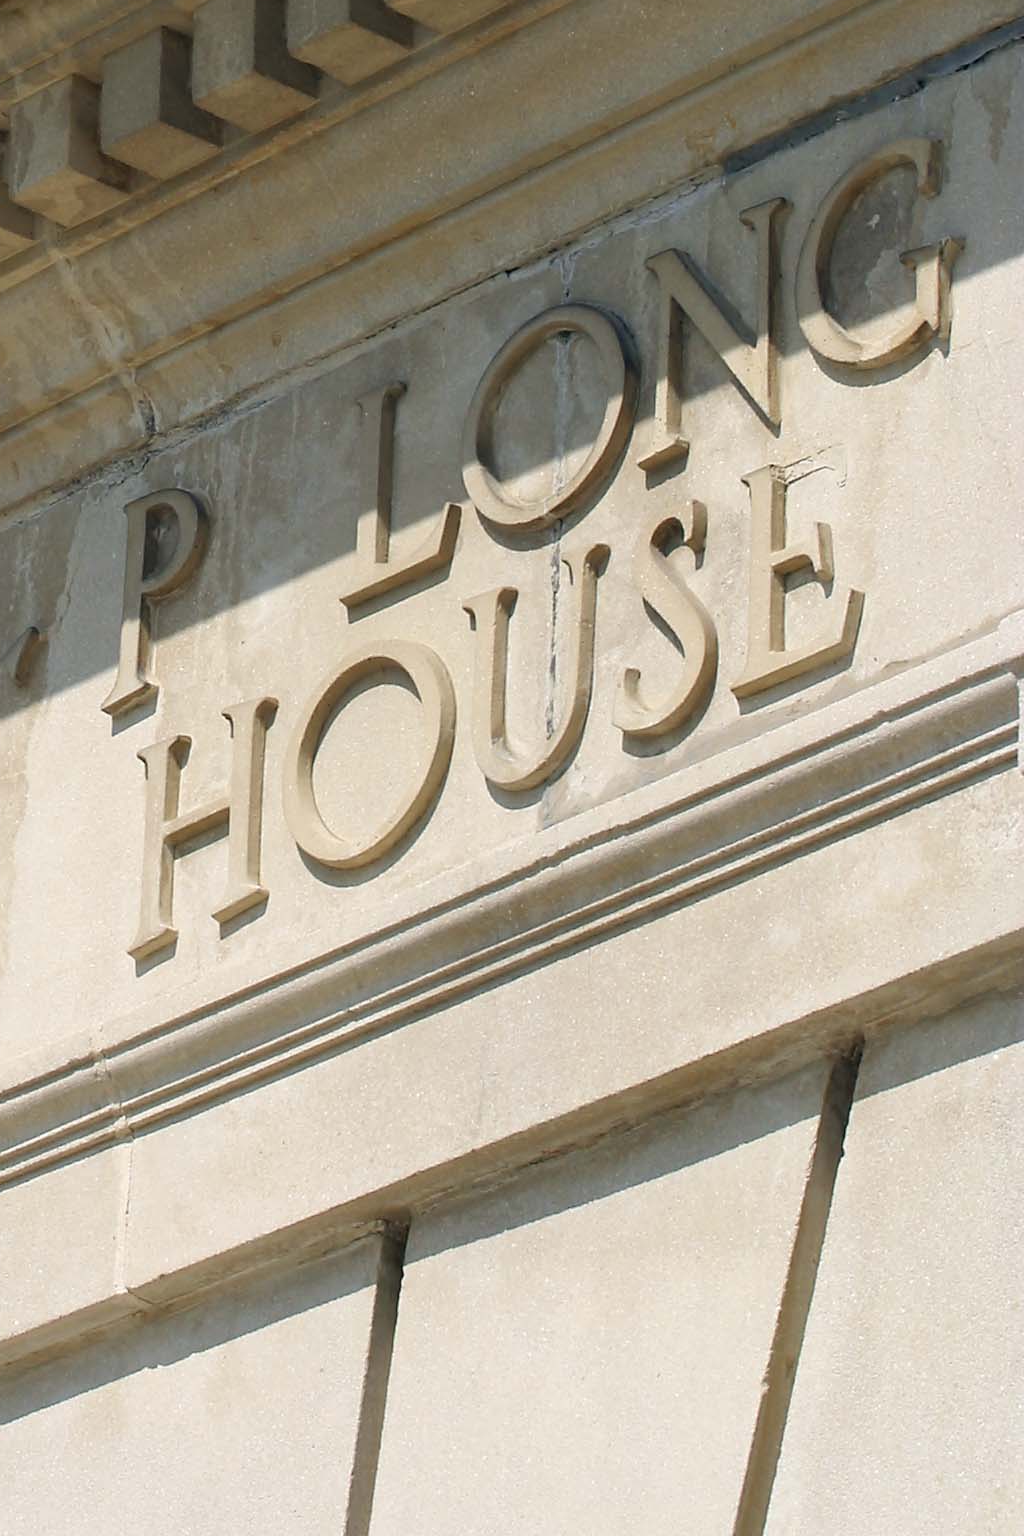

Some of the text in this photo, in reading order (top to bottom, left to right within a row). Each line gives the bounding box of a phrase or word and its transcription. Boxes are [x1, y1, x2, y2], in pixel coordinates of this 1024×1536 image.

[101, 488, 210, 716] P
[340, 139, 964, 614] LONG
[127, 465, 866, 958] HOUSE
